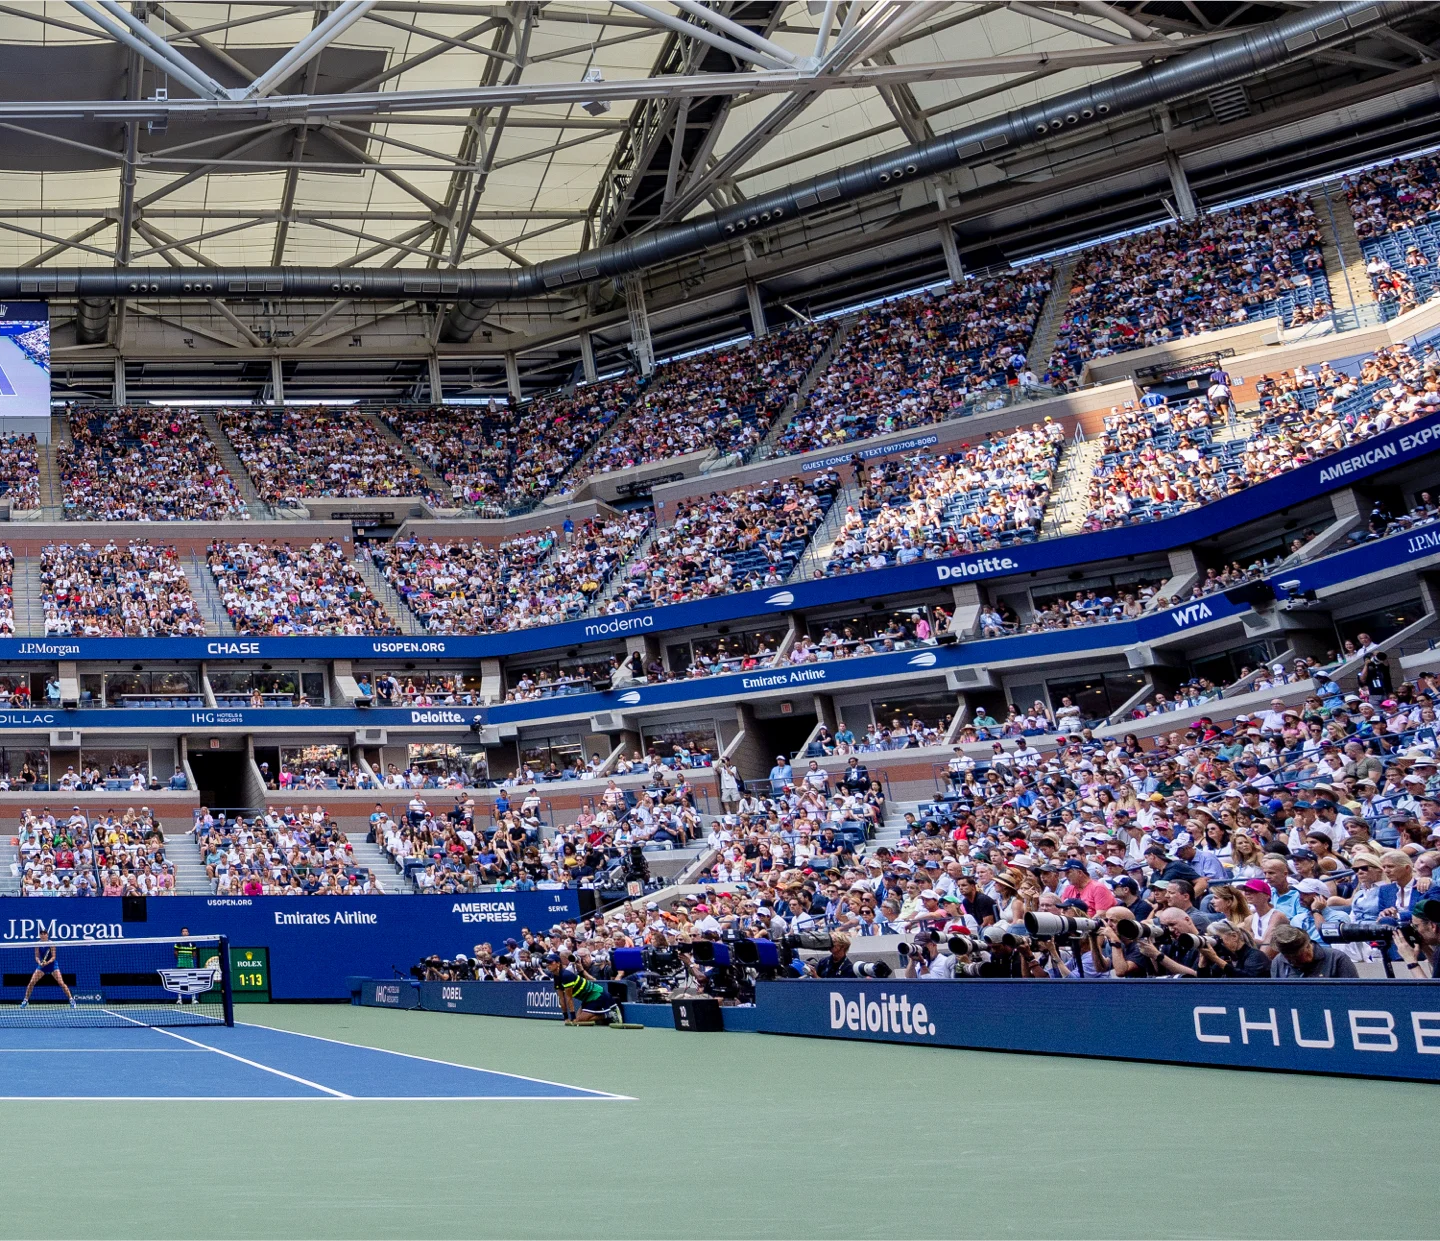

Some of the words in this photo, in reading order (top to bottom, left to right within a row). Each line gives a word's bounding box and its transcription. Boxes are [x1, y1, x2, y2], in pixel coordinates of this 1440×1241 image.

[802, 459, 825, 471] GUEST
[825, 451, 864, 466] CONCE?
[864, 445, 883, 457] TEXT
[883, 435, 937, 454] (917)708-8080
[1319, 442, 1398, 484] AMERICAN
[936, 556, 1019, 580] Deloitte.
[1171, 602, 1213, 627] WTA
[585, 615, 654, 636] moderna
[18, 643, 80, 657] J.P.Morgan
[207, 642, 261, 654] CHASE
[372, 642, 446, 653] USOPEN.ORG
[742, 674, 788, 689] Emirates
[789, 669, 826, 683] Airline
[191, 712, 215, 723] IHG
[411, 710, 466, 723] Deloitte.
[451, 901, 515, 913] AMERICAN
[274, 911, 331, 925] Emirates
[333, 910, 378, 925] Airline
[461, 912, 517, 923] EXPRESS
[3, 919, 124, 941] J.P.Morgan
[236, 959, 263, 968] ROLEX
[239, 973, 263, 986] 1:13
[442, 986, 463, 1000] DOBEL
[829, 991, 936, 1036] Deloitte.
